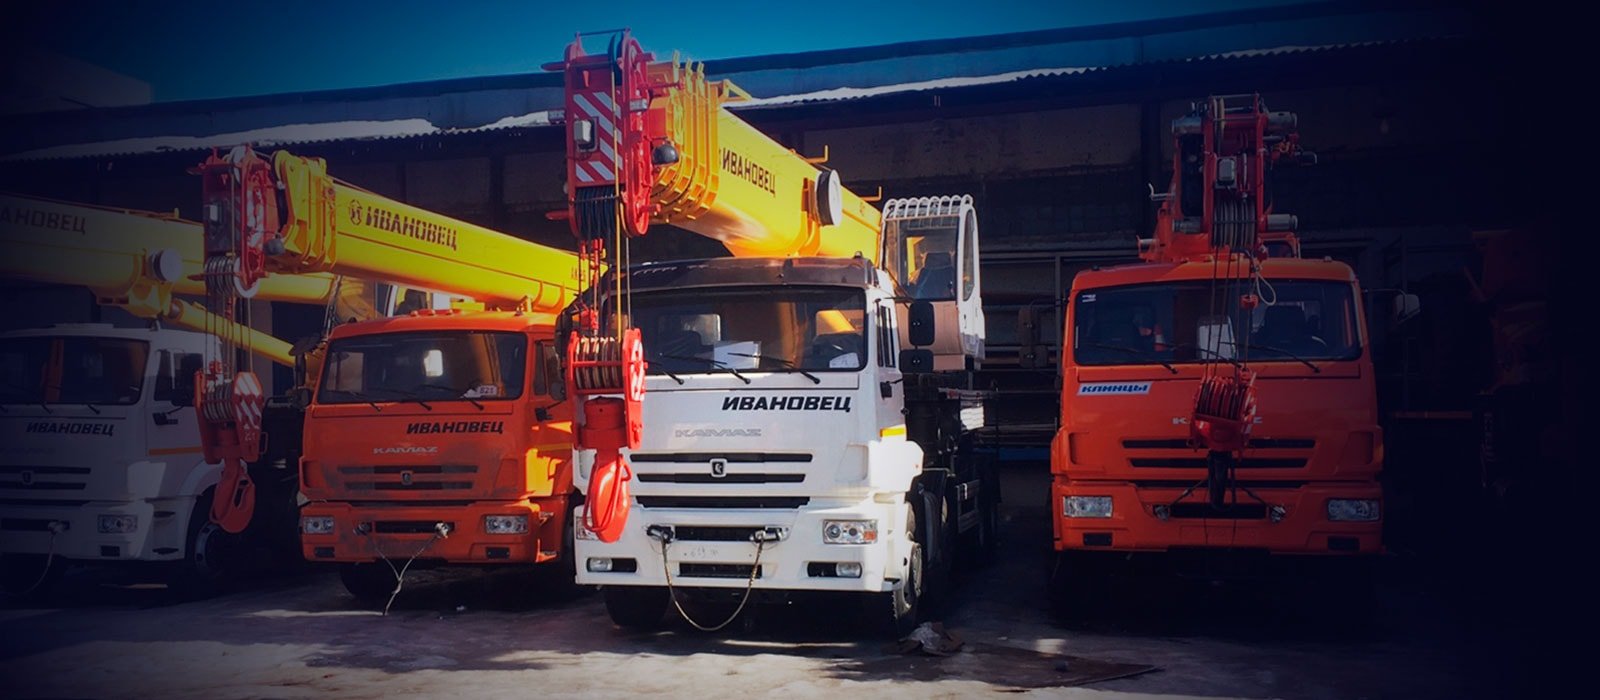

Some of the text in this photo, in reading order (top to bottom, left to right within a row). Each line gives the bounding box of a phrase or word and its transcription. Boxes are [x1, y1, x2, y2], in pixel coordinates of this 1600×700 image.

[722, 147, 776, 198] ИВАНОВЕЦ
[366, 206, 457, 251] ИВАНОВЕЦ
[1081, 384, 1148, 393] КЛИНЦЫ
[722, 396, 851, 412] ИВАНОВЕЦ
[26, 422, 114, 436] ИВАНОВЕЦ
[406, 421, 503, 434] ИВАНОВЕЦ
